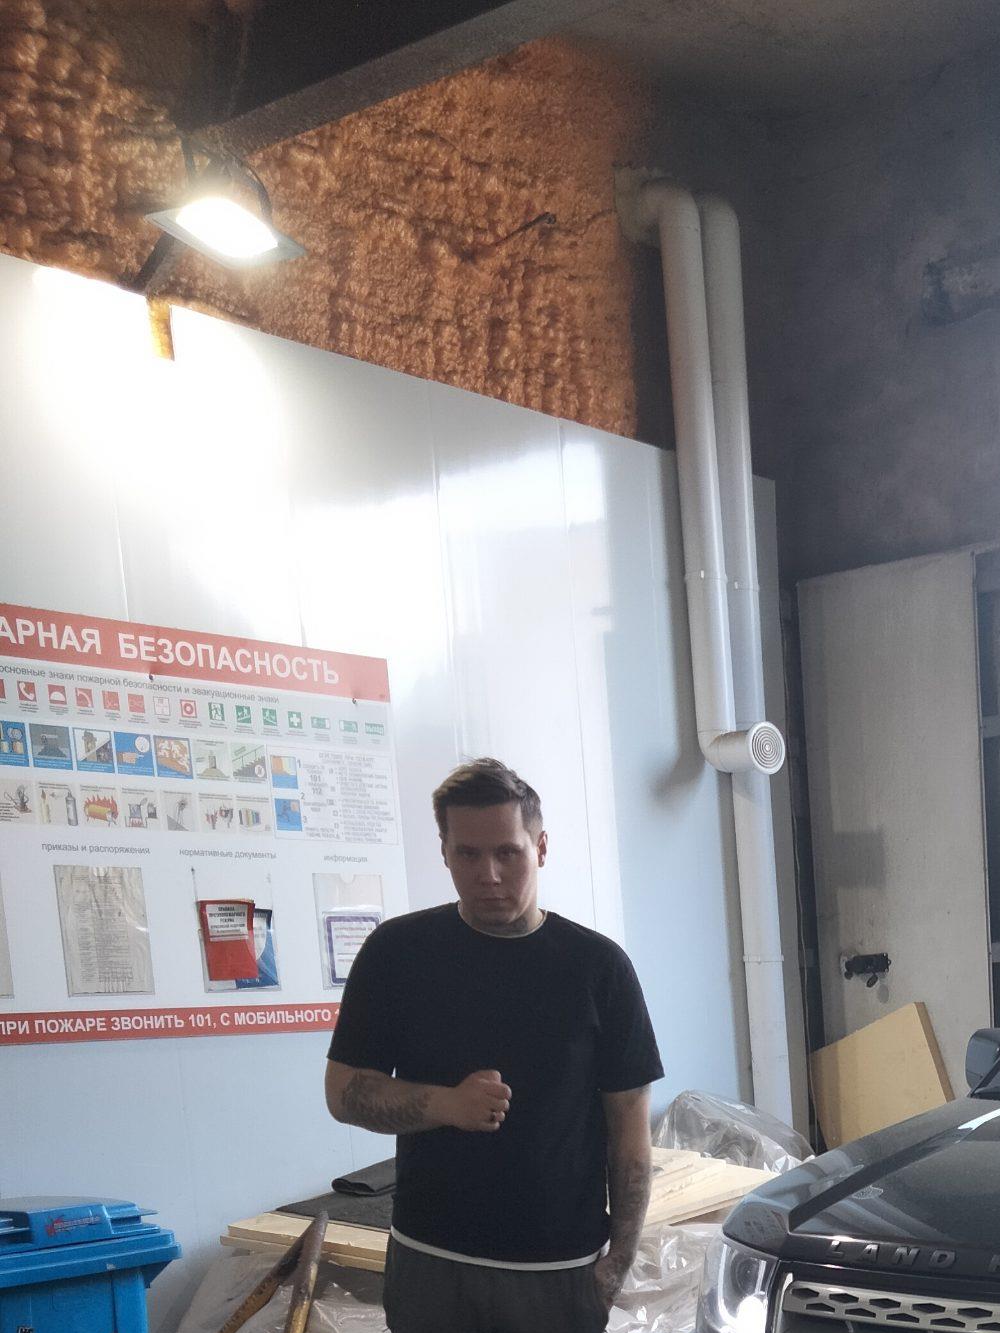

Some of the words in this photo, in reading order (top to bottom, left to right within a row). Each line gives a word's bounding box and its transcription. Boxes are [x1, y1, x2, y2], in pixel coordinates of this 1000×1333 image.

[118, 632, 340, 685] БЕЗОПАСНОСТЬ
[0, 665, 45, 678] основные
[50, 673, 74, 681] знаки
[77, 675, 121, 687] пожарной
[123, 678, 183, 693] безопасности
[192, 687, 256, 702] эвакуационные
[257, 695, 280, 704] знаки
[41, 843, 79, 853] приказы
[89, 845, 151, 855] распоряжения
[179, 848, 233, 859] нормативные
[234, 849, 277, 860] документы
[34, 1017, 107, 1034] ПОЖАРЕ
[111, 1014, 184, 1031] ЗВОНИТЬ
[188, 1013, 217, 1029] 101,
[220, 1012, 230, 1026] С
[234, 1008, 331, 1026] МОБИЛЬНОГО
[826, 1239, 956, 1269] LAND
